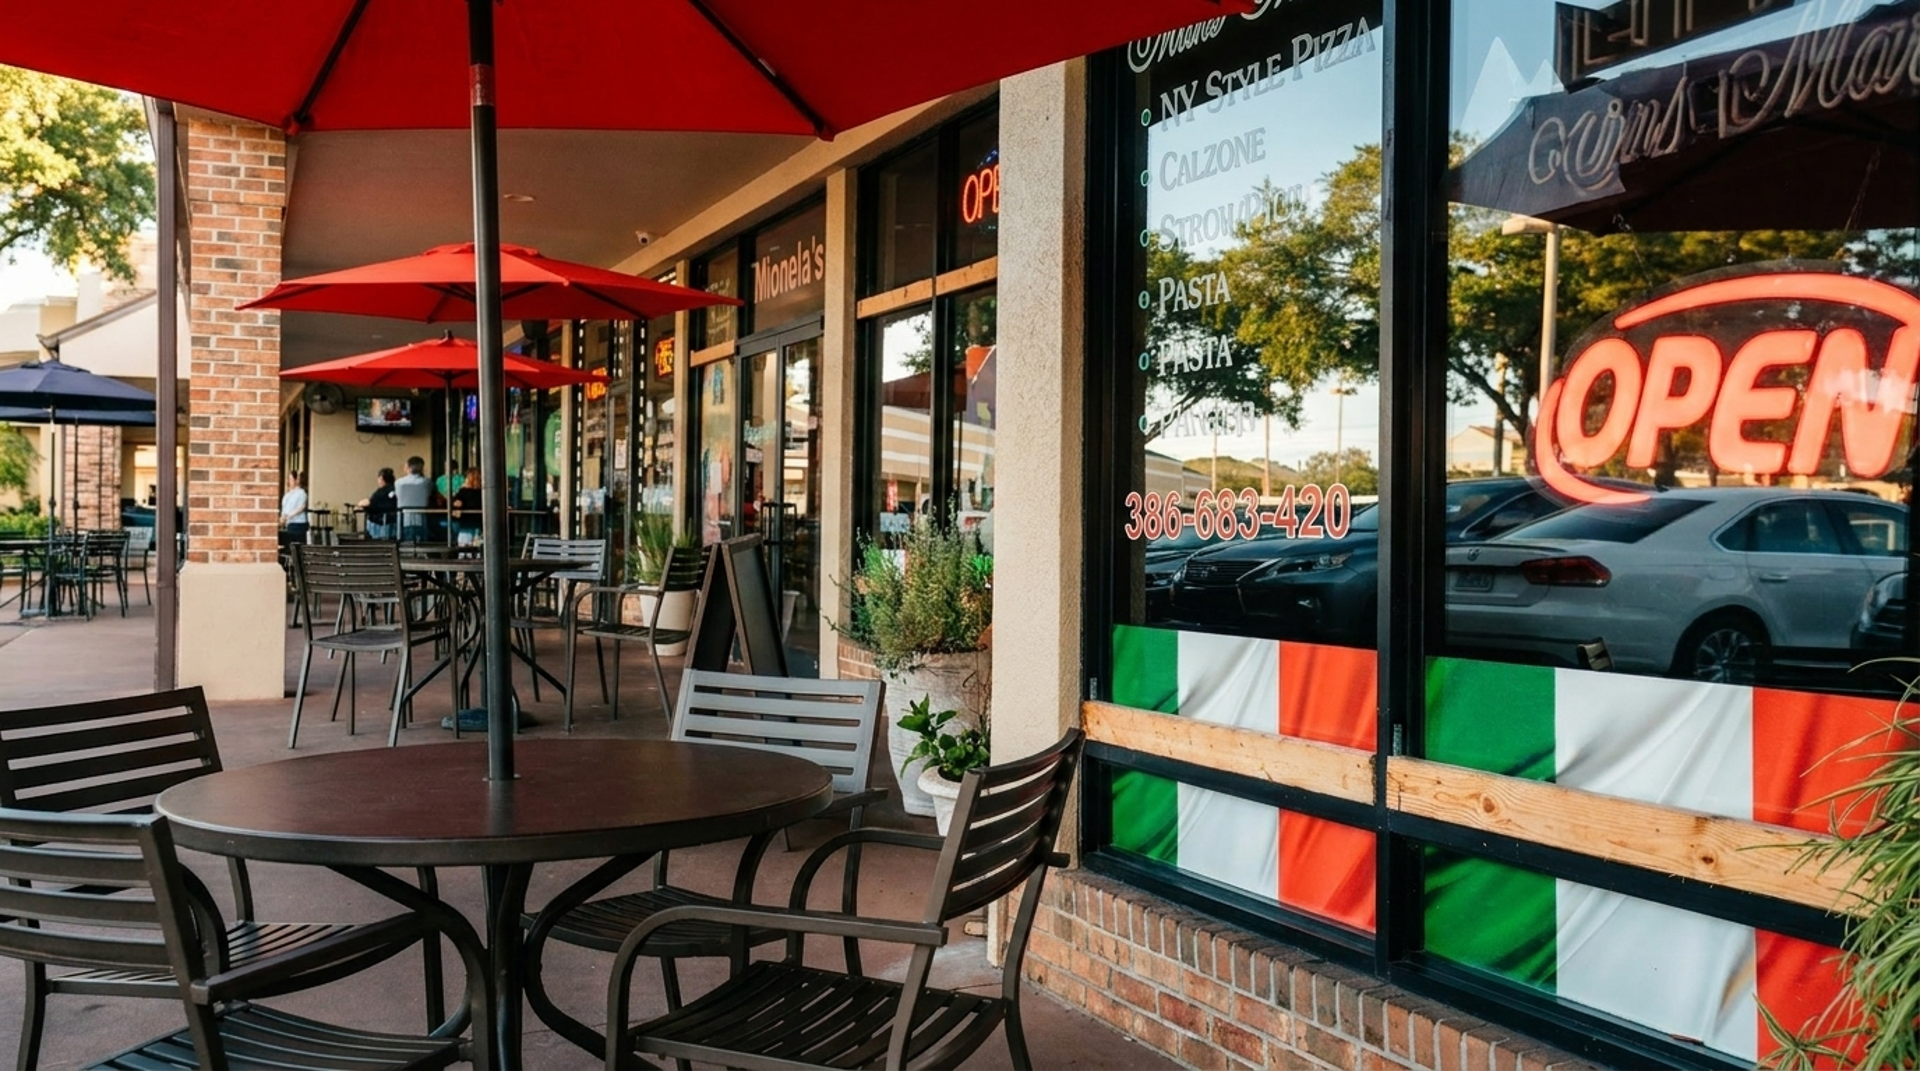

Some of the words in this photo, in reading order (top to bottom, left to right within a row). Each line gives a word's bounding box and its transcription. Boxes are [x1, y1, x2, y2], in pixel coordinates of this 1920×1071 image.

[1159, 80, 1199, 131] NY
[1205, 53, 1285, 113] STYLE
[1291, 16, 1376, 81] PIZZA
[1159, 127, 1267, 191] CALZONE
[754, 235, 824, 304] Mionela's
[1158, 271, 1231, 315] PASTA
[1157, 334, 1233, 377] PASTA
[1556, 327, 1920, 478] OPEN
[1125, 483, 1351, 540] 386-683-420
